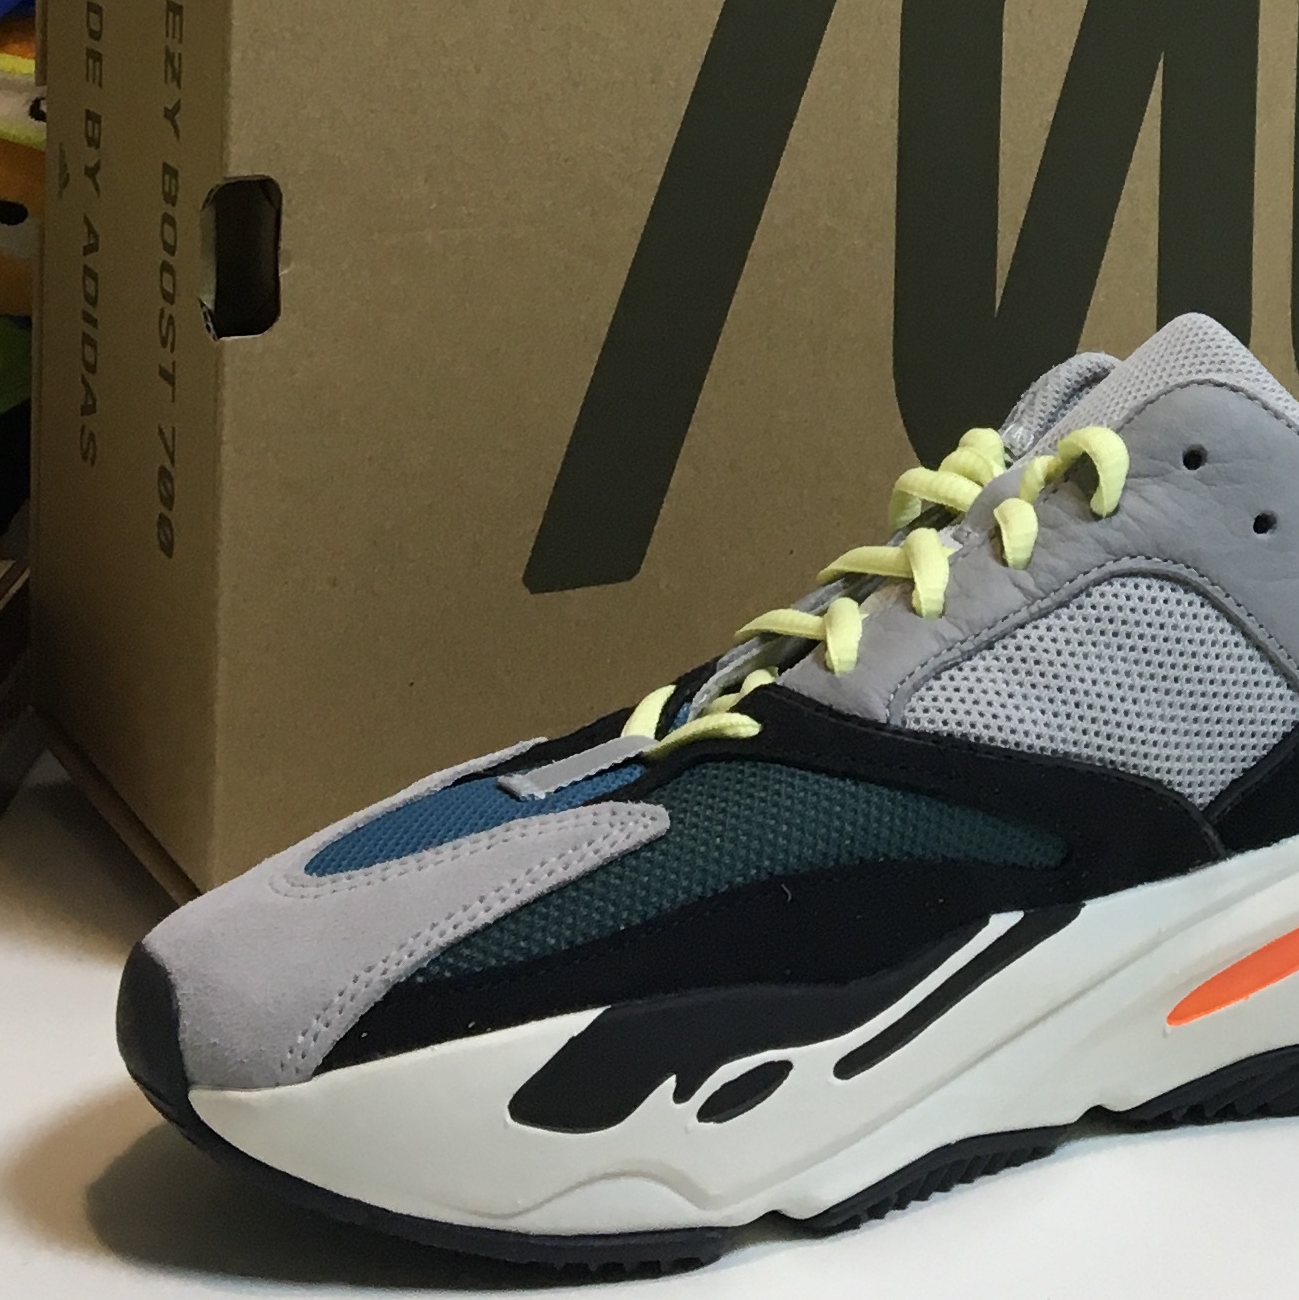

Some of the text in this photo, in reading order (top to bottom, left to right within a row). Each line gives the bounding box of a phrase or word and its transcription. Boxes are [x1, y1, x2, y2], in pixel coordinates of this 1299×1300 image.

[83, 108, 102, 198] BY
[80, 213, 99, 467] ADIDAS
[158, 161, 179, 403] BOOST
[156, 423, 176, 560] 700
